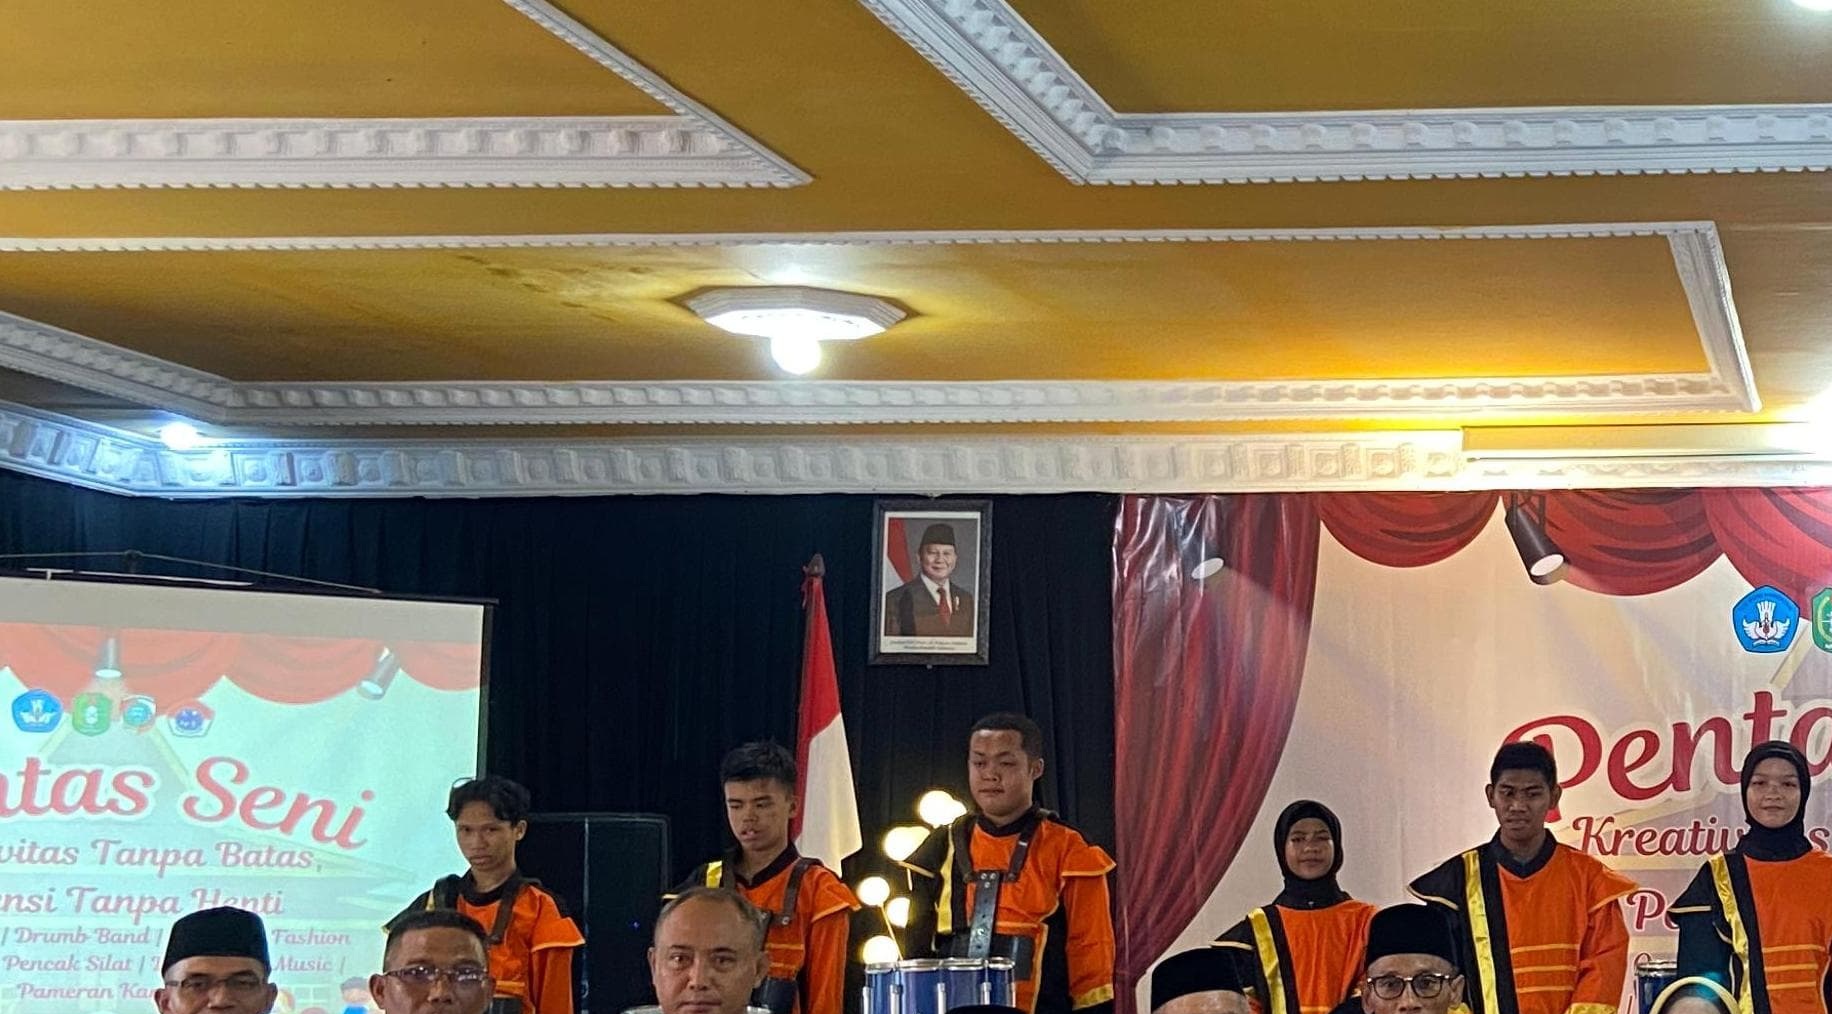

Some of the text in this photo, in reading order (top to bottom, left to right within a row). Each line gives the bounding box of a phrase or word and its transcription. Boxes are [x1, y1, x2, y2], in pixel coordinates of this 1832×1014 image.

[0, 756, 375, 850] tas Seni
[1572, 815, 1830, 854] Kreativs
[91, 838, 206, 878] Tanpa
[66, 886, 182, 925] Tanpa
[14, 925, 89, 944] Drumb
[94, 925, 150, 944] Band
[271, 926, 351, 946] Fashion
[2, 953, 81, 971] Pencak
[85, 953, 133, 972] Silat
[272, 954, 333, 972] Music
[16, 982, 114, 1000] Pameran
